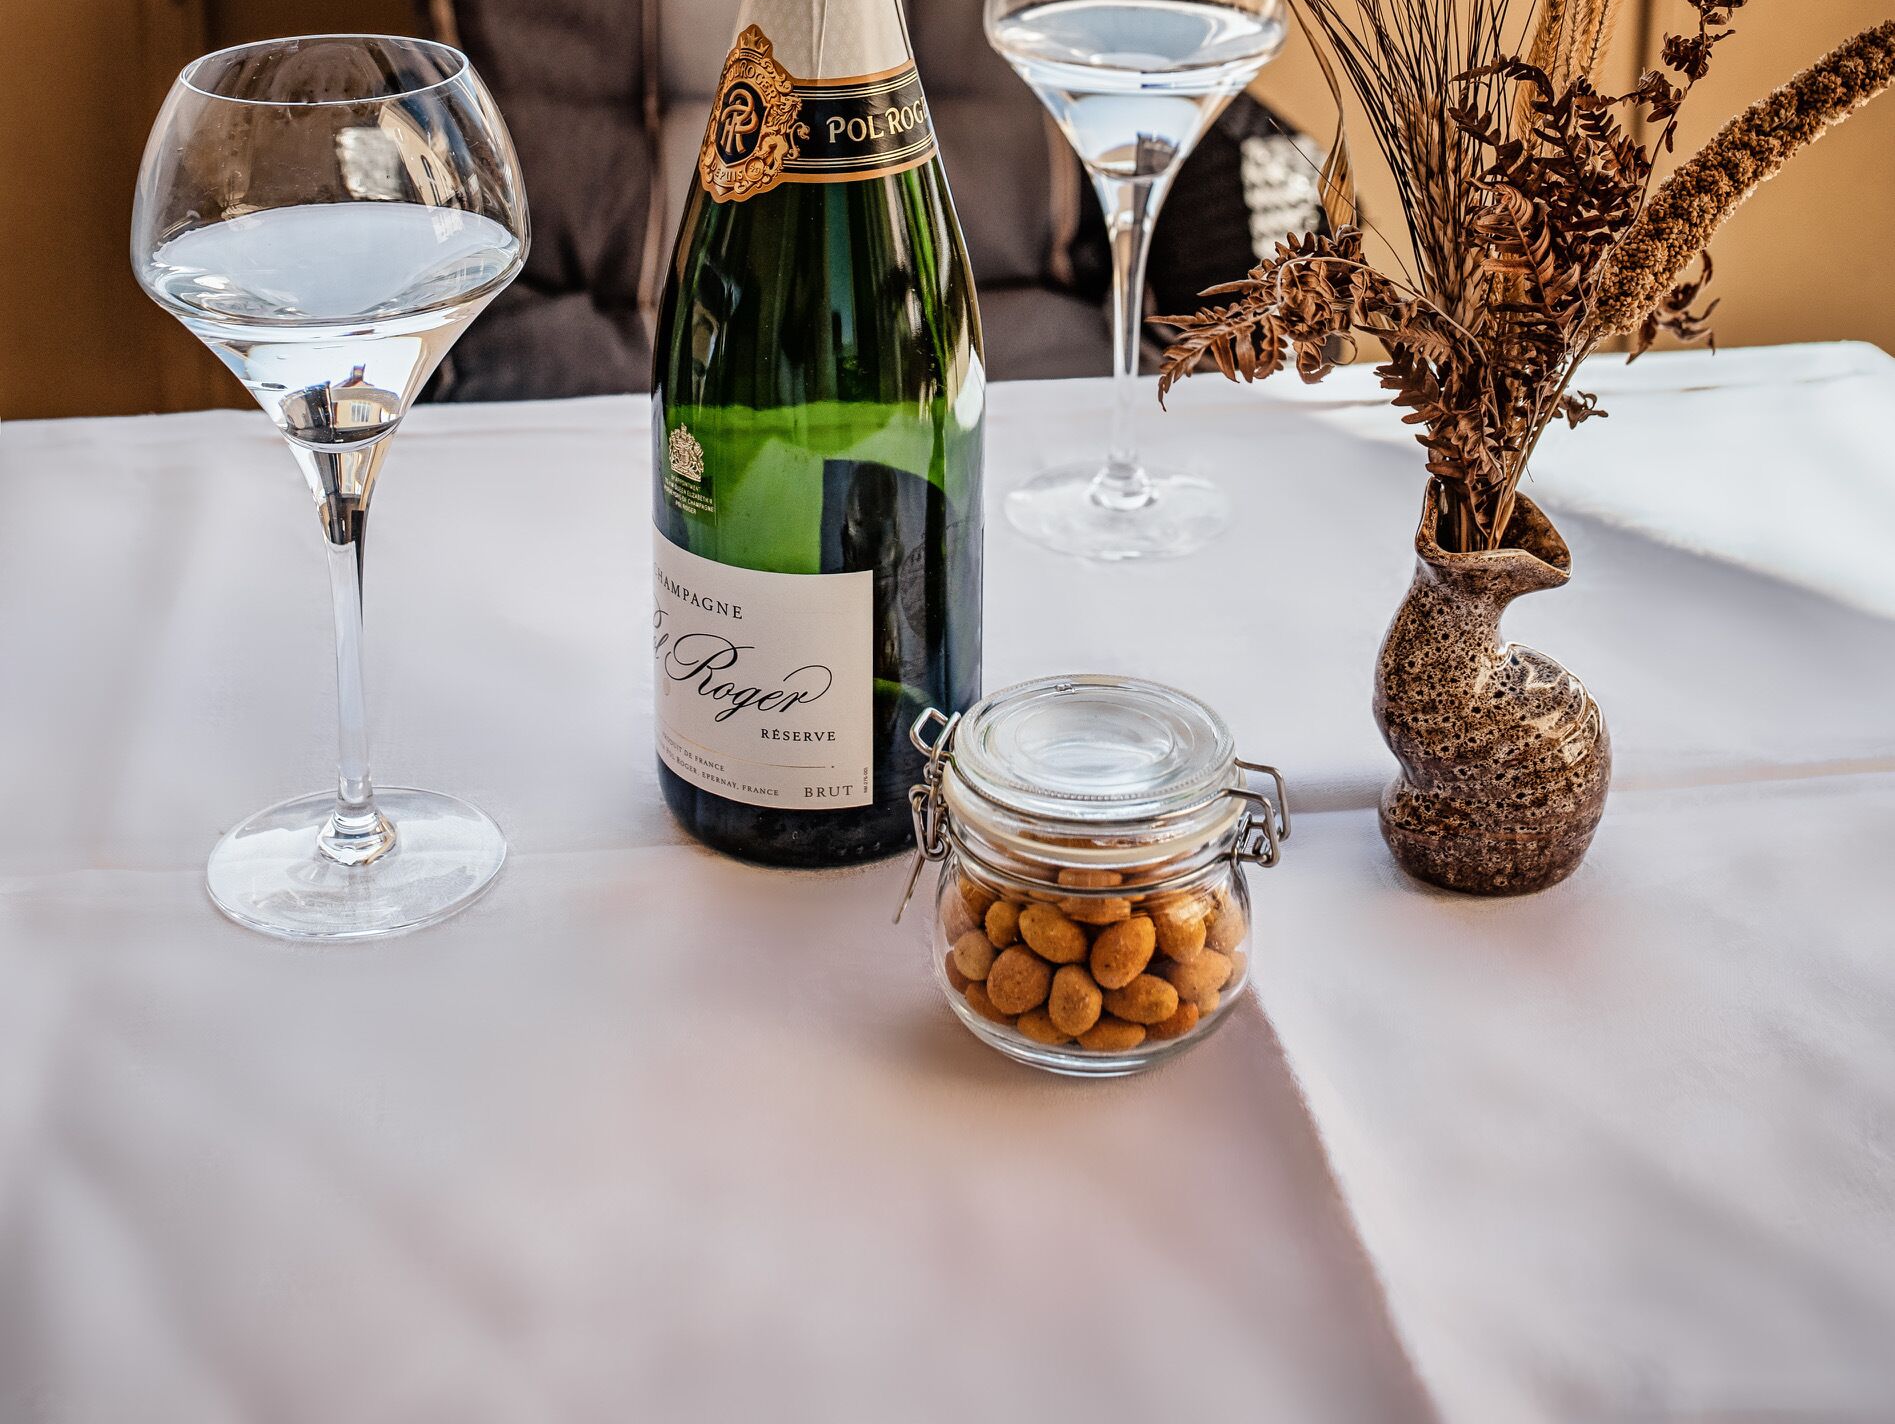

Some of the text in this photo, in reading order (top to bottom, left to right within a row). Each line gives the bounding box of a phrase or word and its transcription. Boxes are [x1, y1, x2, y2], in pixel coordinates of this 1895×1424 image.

[739, 60, 778, 104] ROGER
[826, 96, 929, 144] POL ROGE
[711, 161, 744, 184] DEPUIS
[665, 633, 833, 723] Roger
[760, 728, 836, 742] RÉSERVE
[684, 749, 693, 760] DE
[695, 756, 726, 772] FRANCE
[742, 784, 779, 796] FRANCE
[803, 784, 854, 798] BRUT
